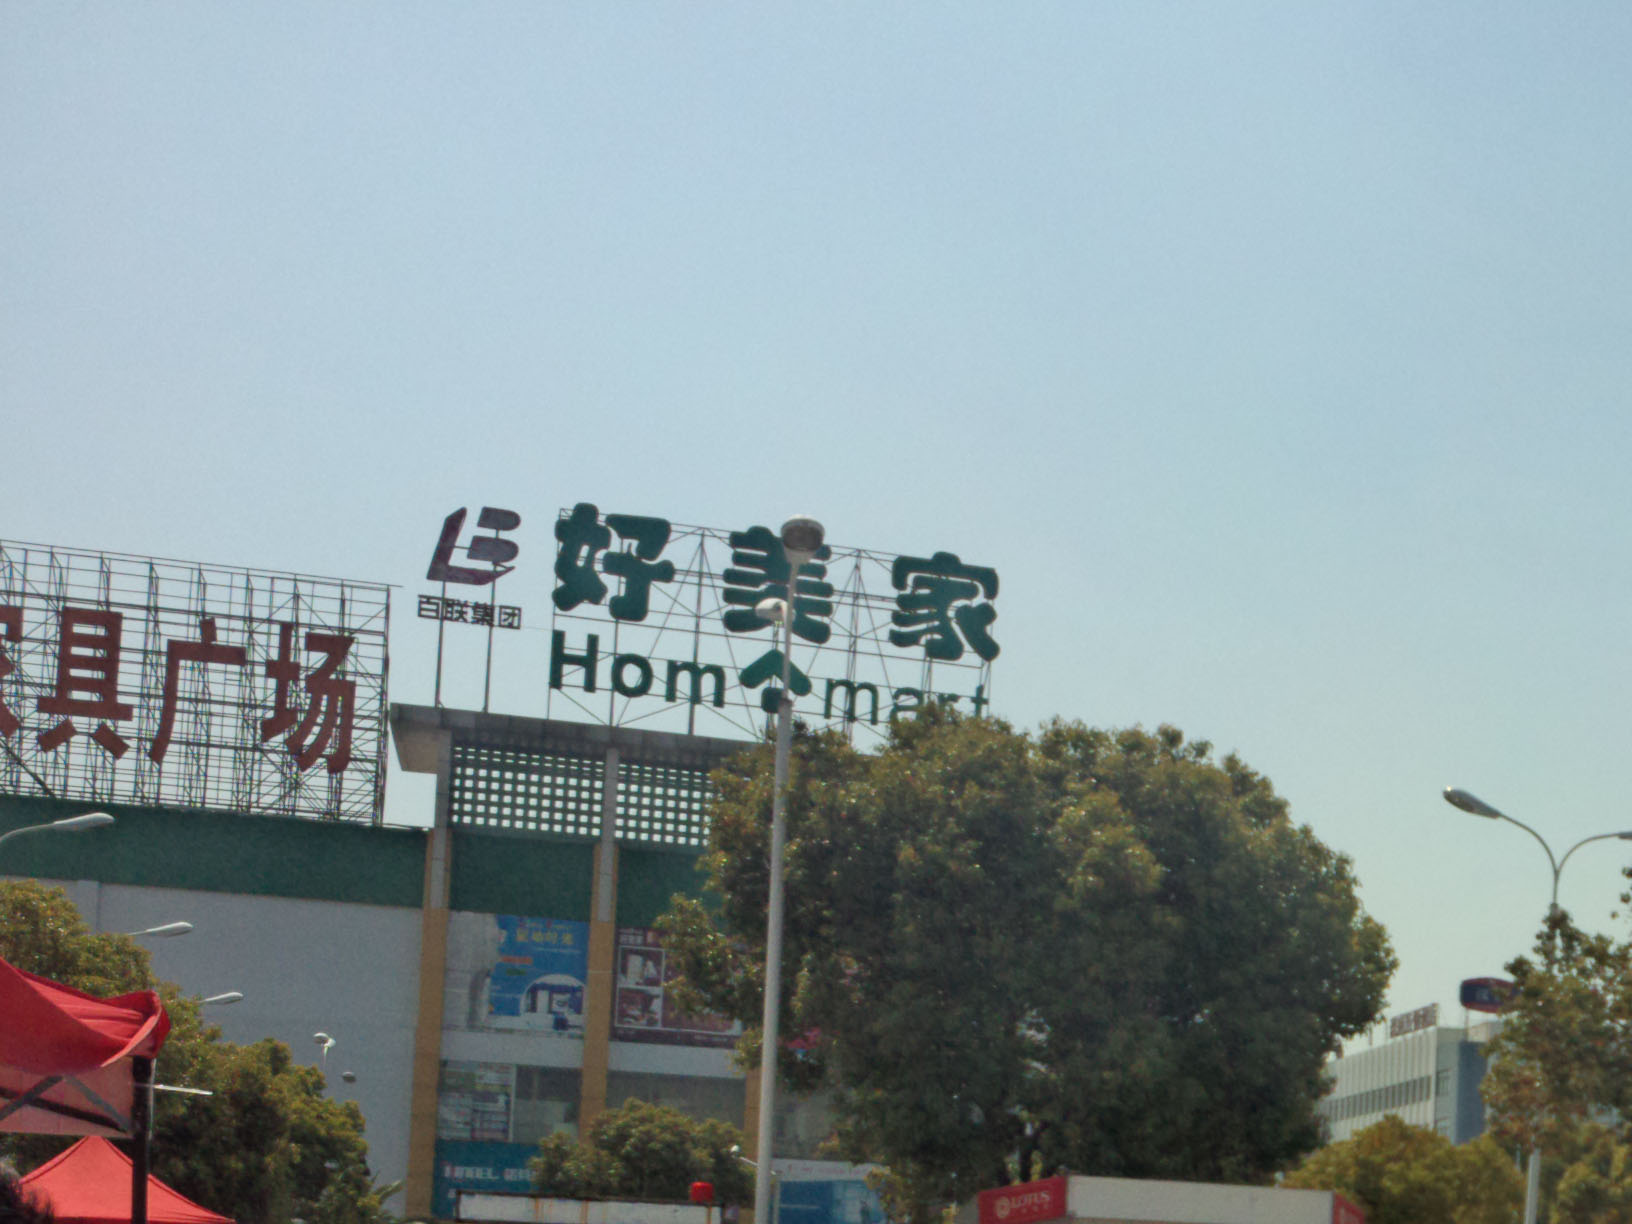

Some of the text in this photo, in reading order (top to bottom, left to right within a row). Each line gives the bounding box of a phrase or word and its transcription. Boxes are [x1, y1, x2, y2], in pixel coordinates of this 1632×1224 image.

[417, 594, 522, 630] 百联集团
[552, 502, 1000, 662] 好美家
[0, 604, 357, 775] 具广场
